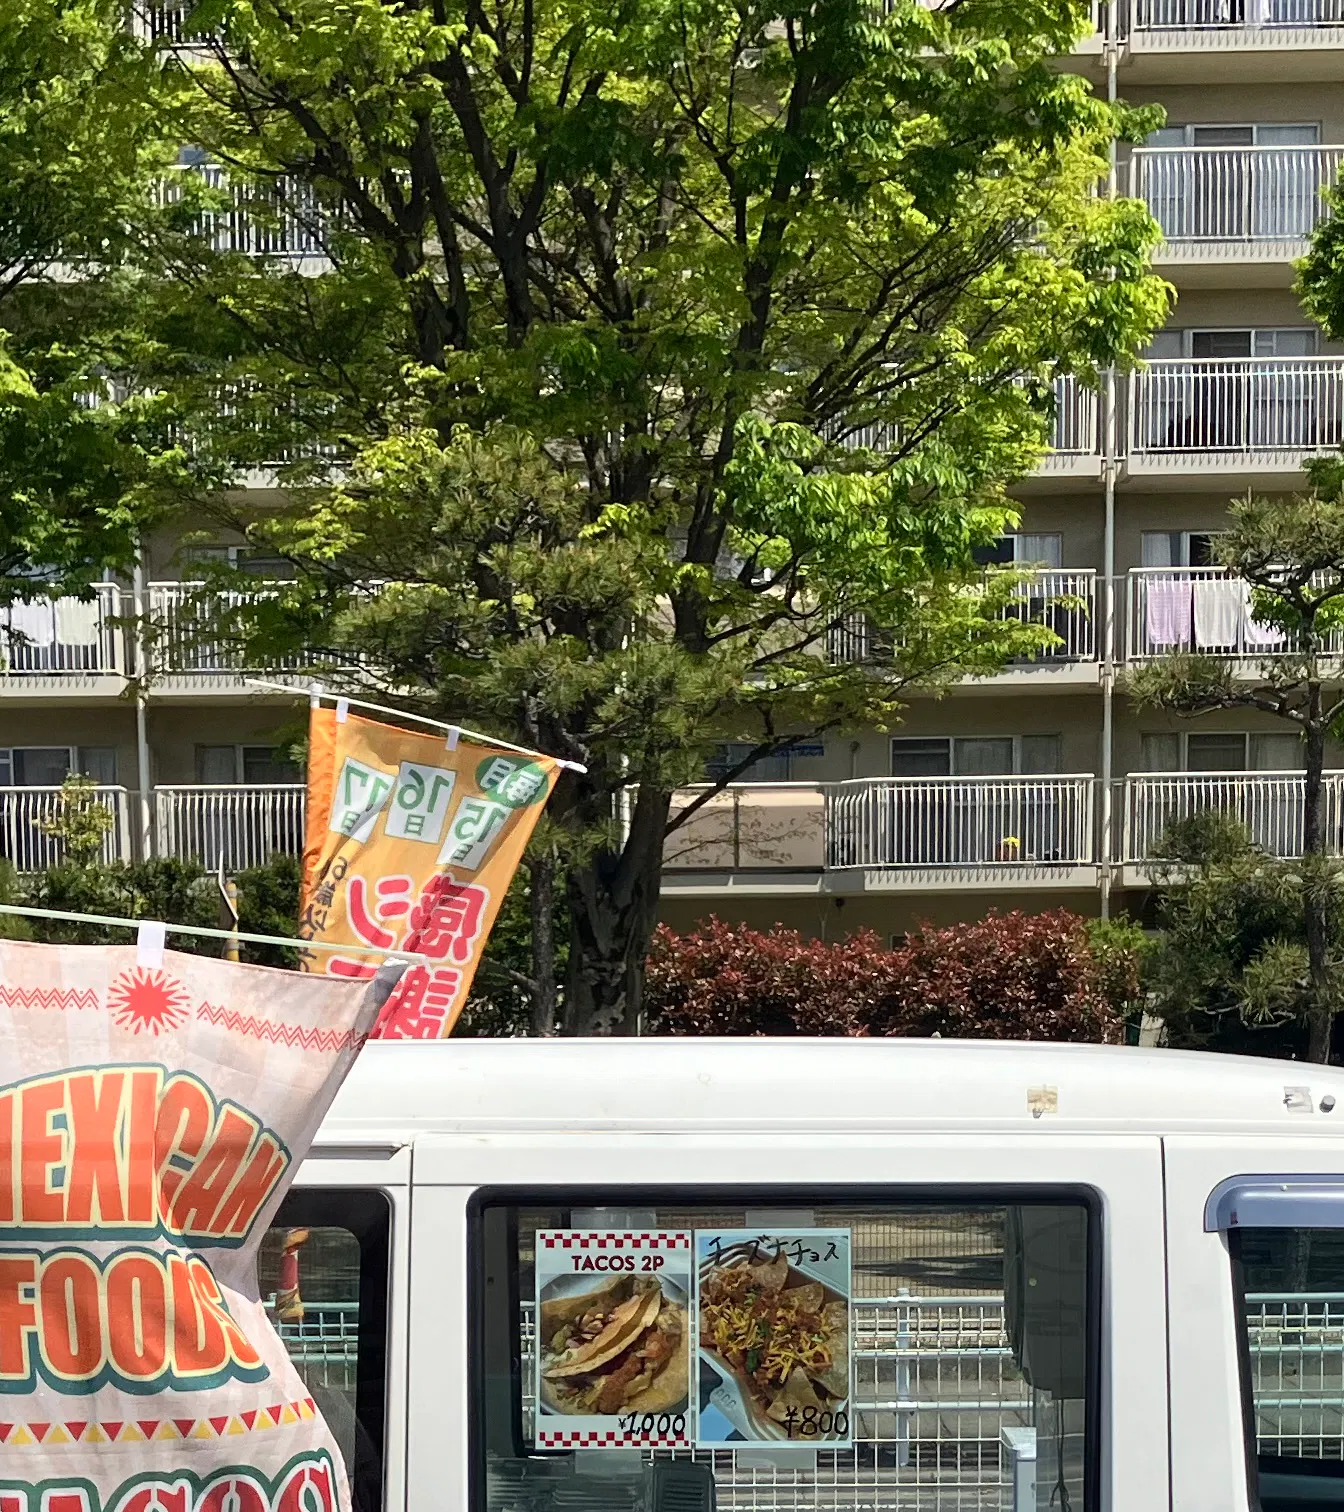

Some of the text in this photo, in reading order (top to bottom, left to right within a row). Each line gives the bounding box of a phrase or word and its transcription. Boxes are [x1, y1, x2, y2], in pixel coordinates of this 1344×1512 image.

[572, 1255, 664, 1271] TACOS 2P
[786, 1406, 849, 1437] ¥800
